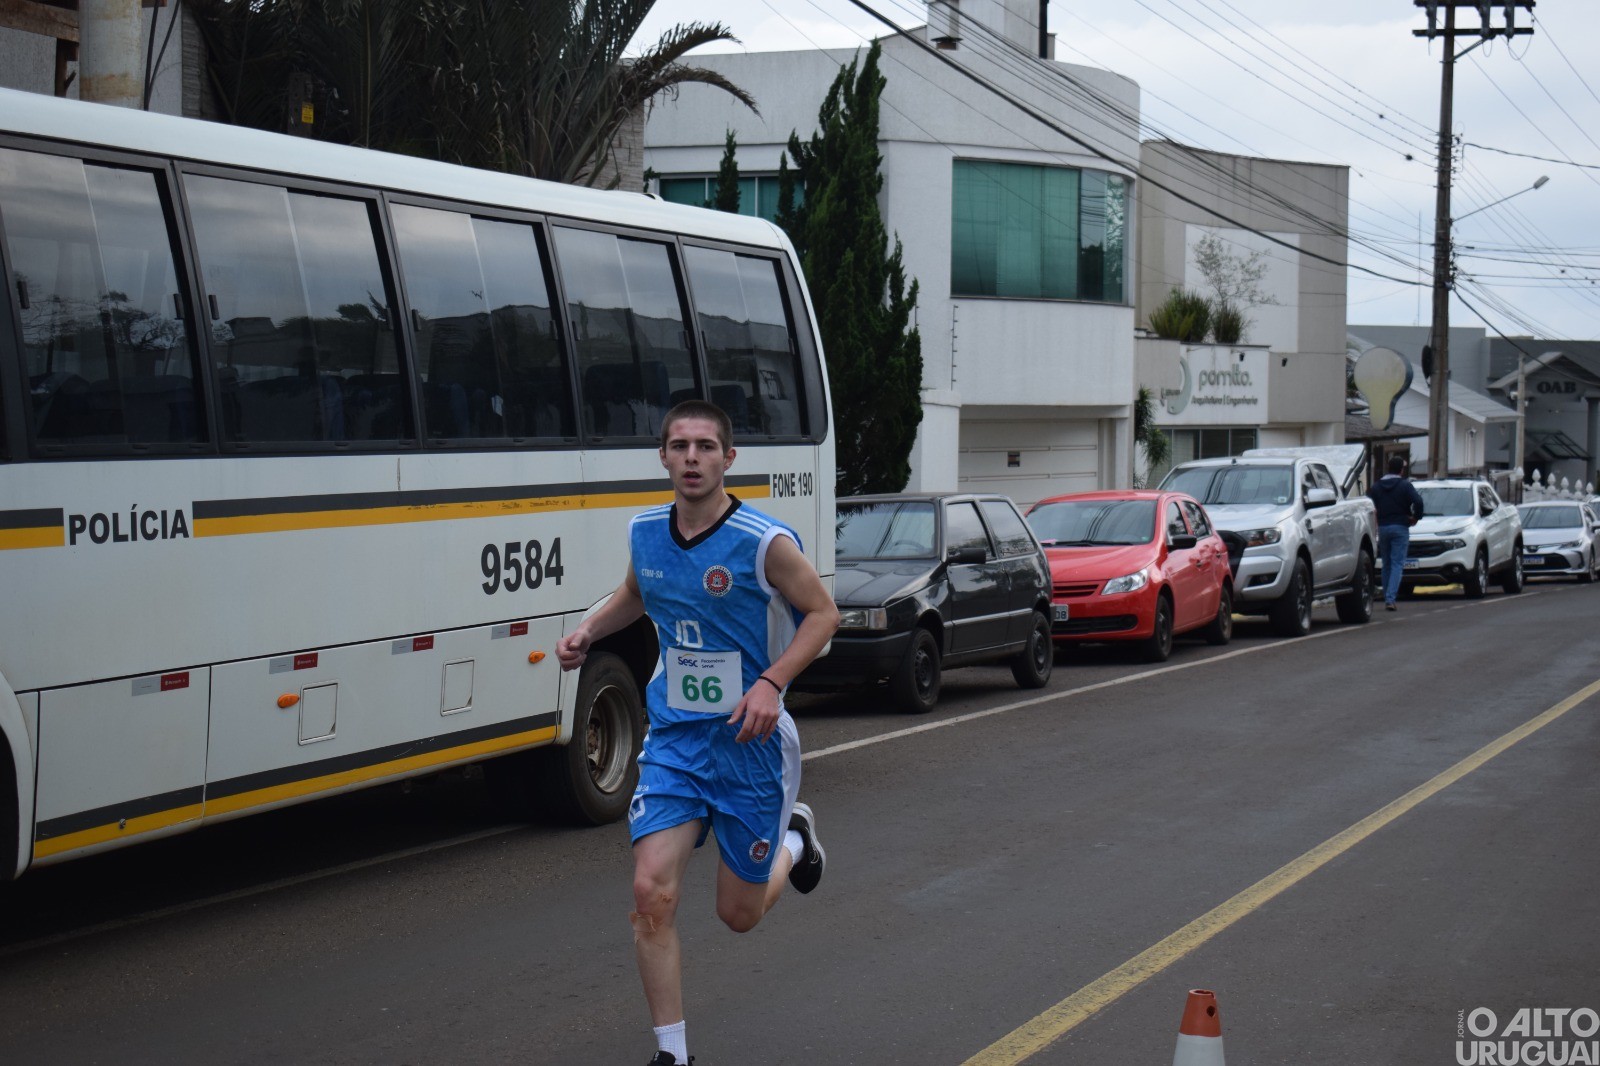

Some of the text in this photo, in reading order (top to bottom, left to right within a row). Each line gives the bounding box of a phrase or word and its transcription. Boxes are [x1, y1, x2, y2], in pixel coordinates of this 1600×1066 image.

[1537, 381, 1576, 394] OAB
[772, 472, 813, 498] FONE 190
[69, 503, 189, 546] POLÍCIA
[481, 537, 564, 595] 9584
[682, 674, 723, 703] 66
